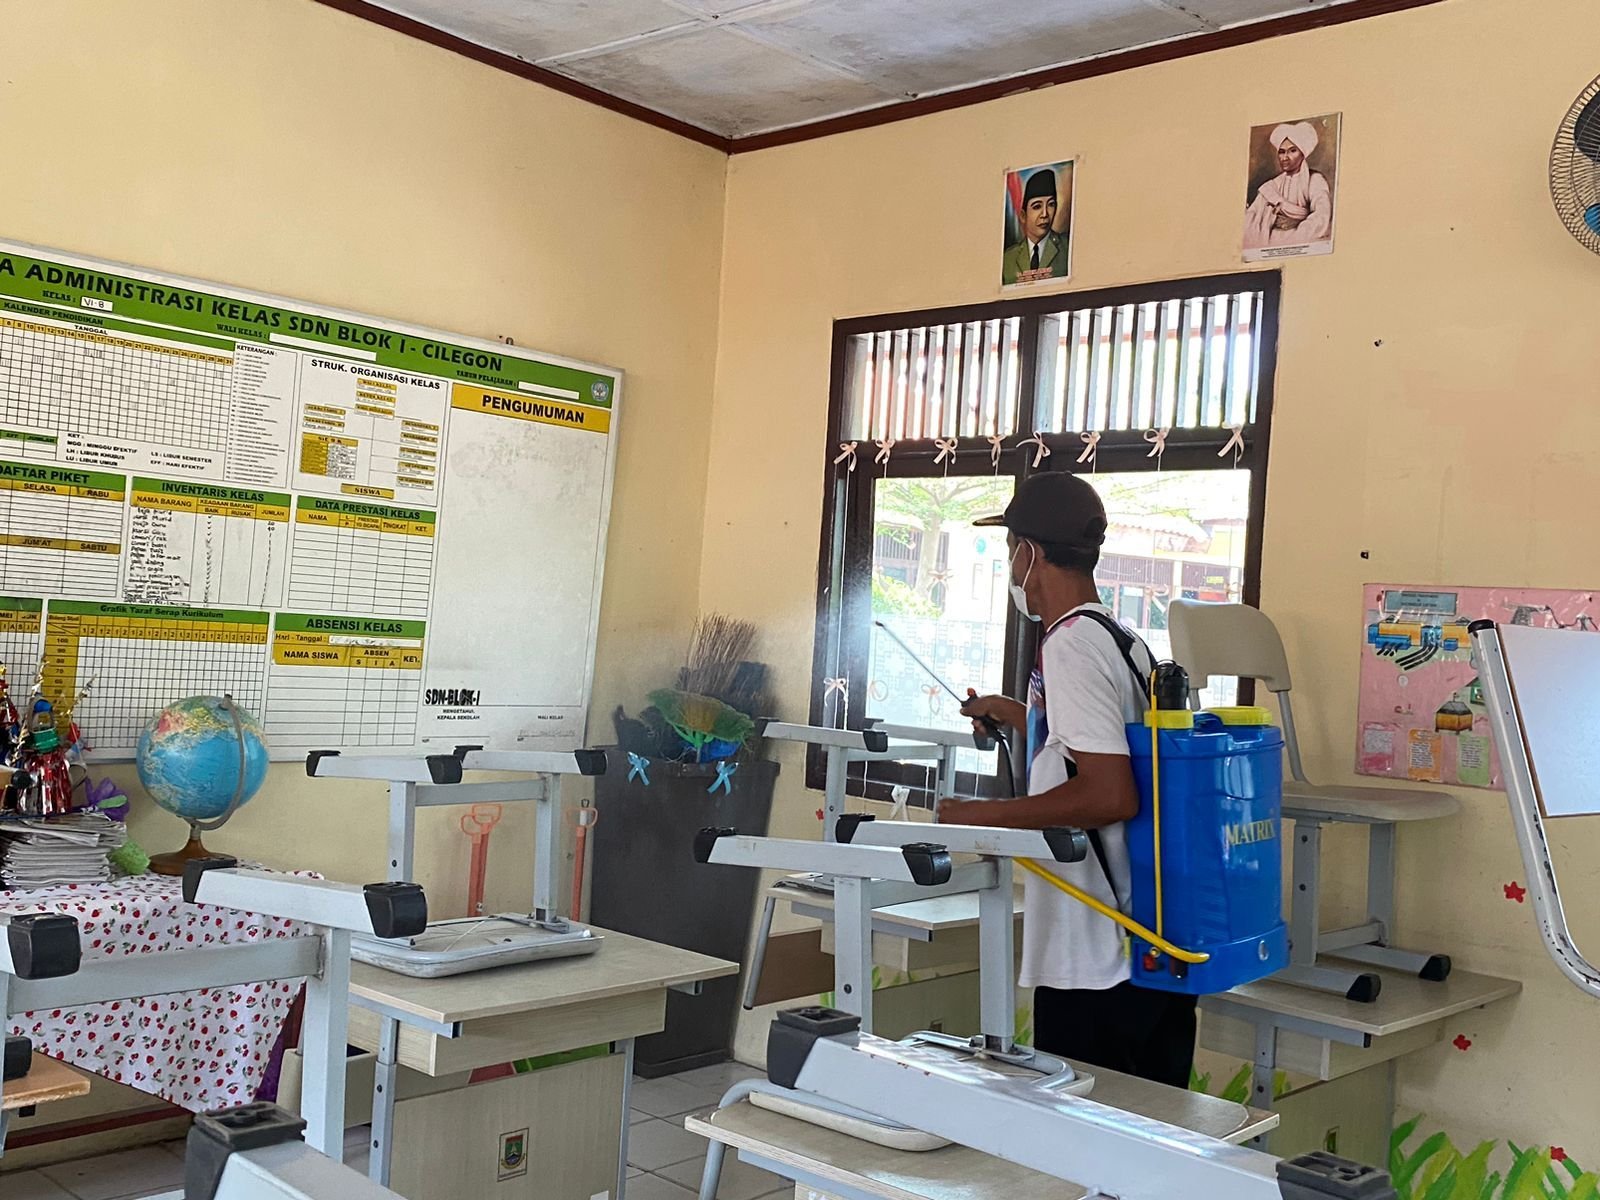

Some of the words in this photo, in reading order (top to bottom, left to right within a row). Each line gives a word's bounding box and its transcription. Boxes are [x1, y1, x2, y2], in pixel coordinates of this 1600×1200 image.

[42, 290, 71, 302] KELAS
[4, 302, 50, 317] KALENDER
[52, 310, 104, 325] PENDIDIKAN
[25, 264, 203, 313] ADMINISTRASI
[212, 300, 281, 327] KELAS
[288, 315, 330, 337] SDN
[338, 325, 392, 350] BLOK
[400, 338, 406, 353] I
[422, 343, 502, 371] CILEGON
[74, 324, 108, 336] TANGGAL
[216, 323, 237, 334] WALI
[238, 327, 262, 339] KELAS
[236, 344, 274, 355] KETERANGAN
[311, 359, 347, 372] STRUK.
[350, 366, 408, 384] ORGANISASI
[410, 376, 440, 390] KELAS
[482, 394, 585, 424] PENGUMUMAN
[87, 442, 112, 450] MINGGU
[182, 456, 212, 464] SEMESTER
[50, 470, 90, 484] PIKET
[24, 482, 56, 492] SELASA
[162, 482, 227, 498] INVENTARIS
[230, 490, 264, 502] KELAS
[354, 487, 381, 496] SISWA
[86, 489, 110, 498] RABU
[136, 495, 159, 504] NAMA
[160, 498, 192, 508] BARANG
[315, 500, 340, 511] DATA
[342, 503, 388, 516] PRESTASI
[390, 509, 420, 520] KELAS
[308, 513, 328, 522] NAMA
[382, 522, 406, 530] TINGKAT
[22, 538, 52, 548] JUM'AT
[80, 542, 108, 552] SABTU
[100, 604, 127, 613] Grafik
[154, 608, 180, 617] Serap
[182, 610, 224, 618] Kurikulum
[306, 618, 360, 631] ABSENSI
[364, 622, 403, 633] KELAS
[275, 633, 290, 641] Hari
[296, 634, 322, 642] Tanggal
[284, 650, 309, 659] NAMA
[312, 652, 338, 660] SISWA
